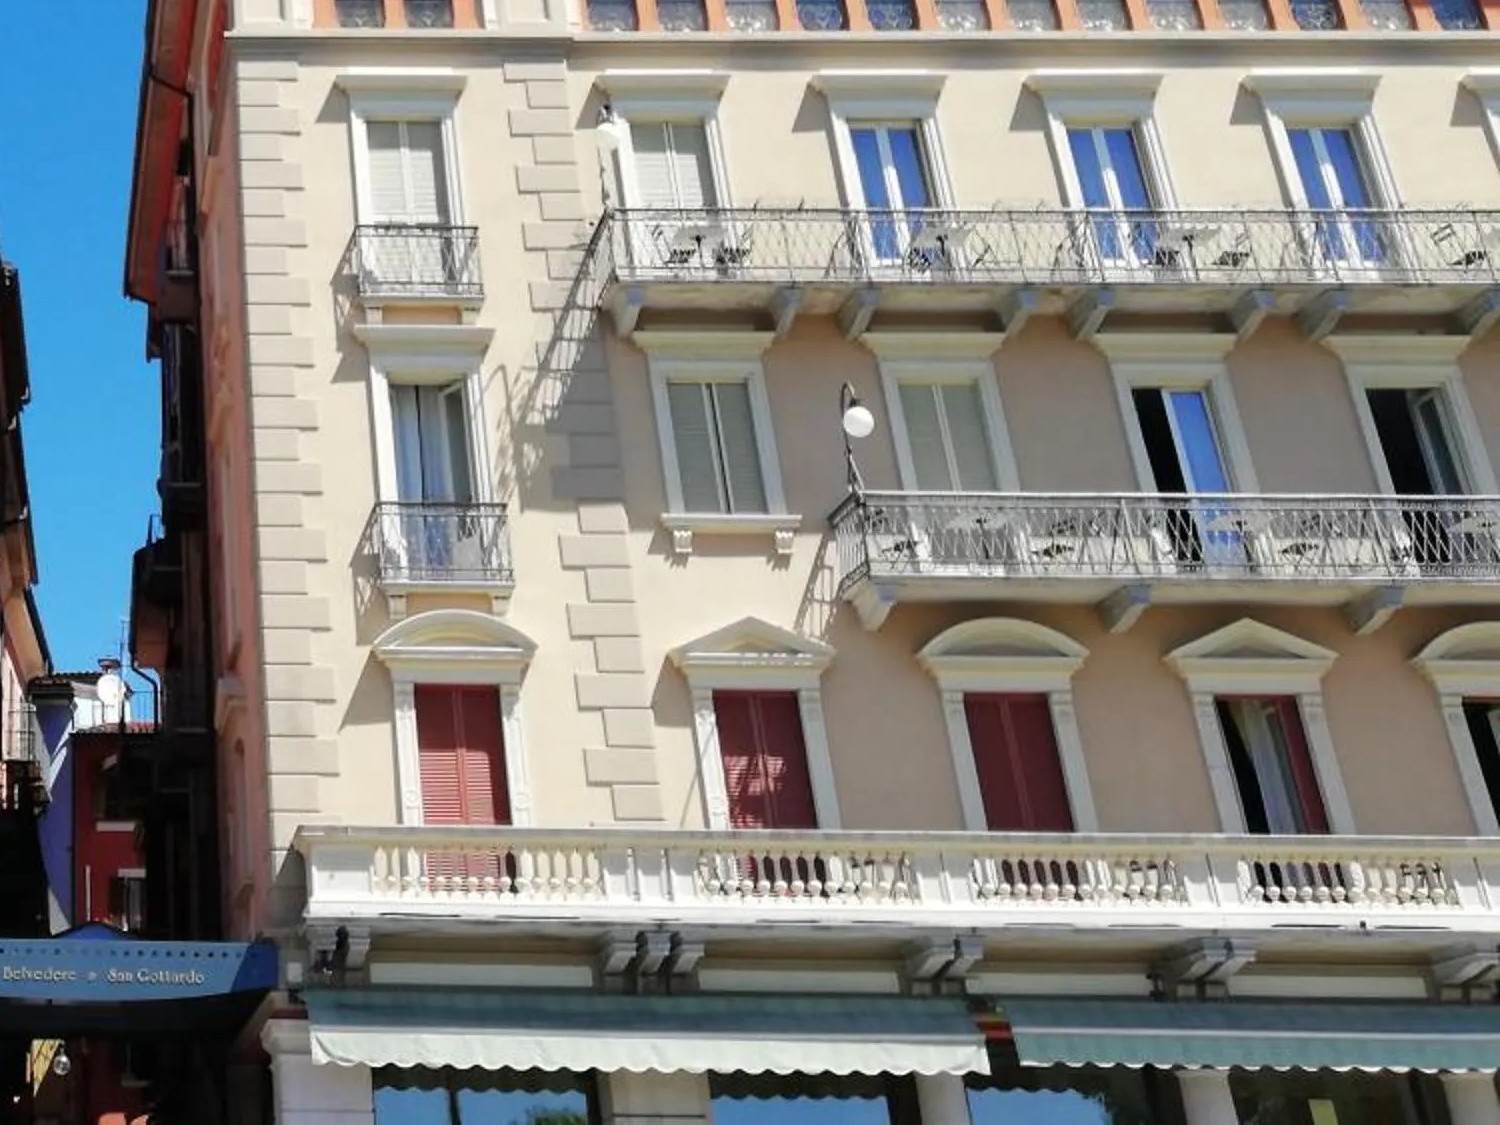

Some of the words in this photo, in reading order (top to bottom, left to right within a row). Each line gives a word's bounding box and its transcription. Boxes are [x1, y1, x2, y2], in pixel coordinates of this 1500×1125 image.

[3, 965, 77, 982] Belvedere
[107, 968, 134, 983] San
[137, 968, 205, 984] Gottardo
